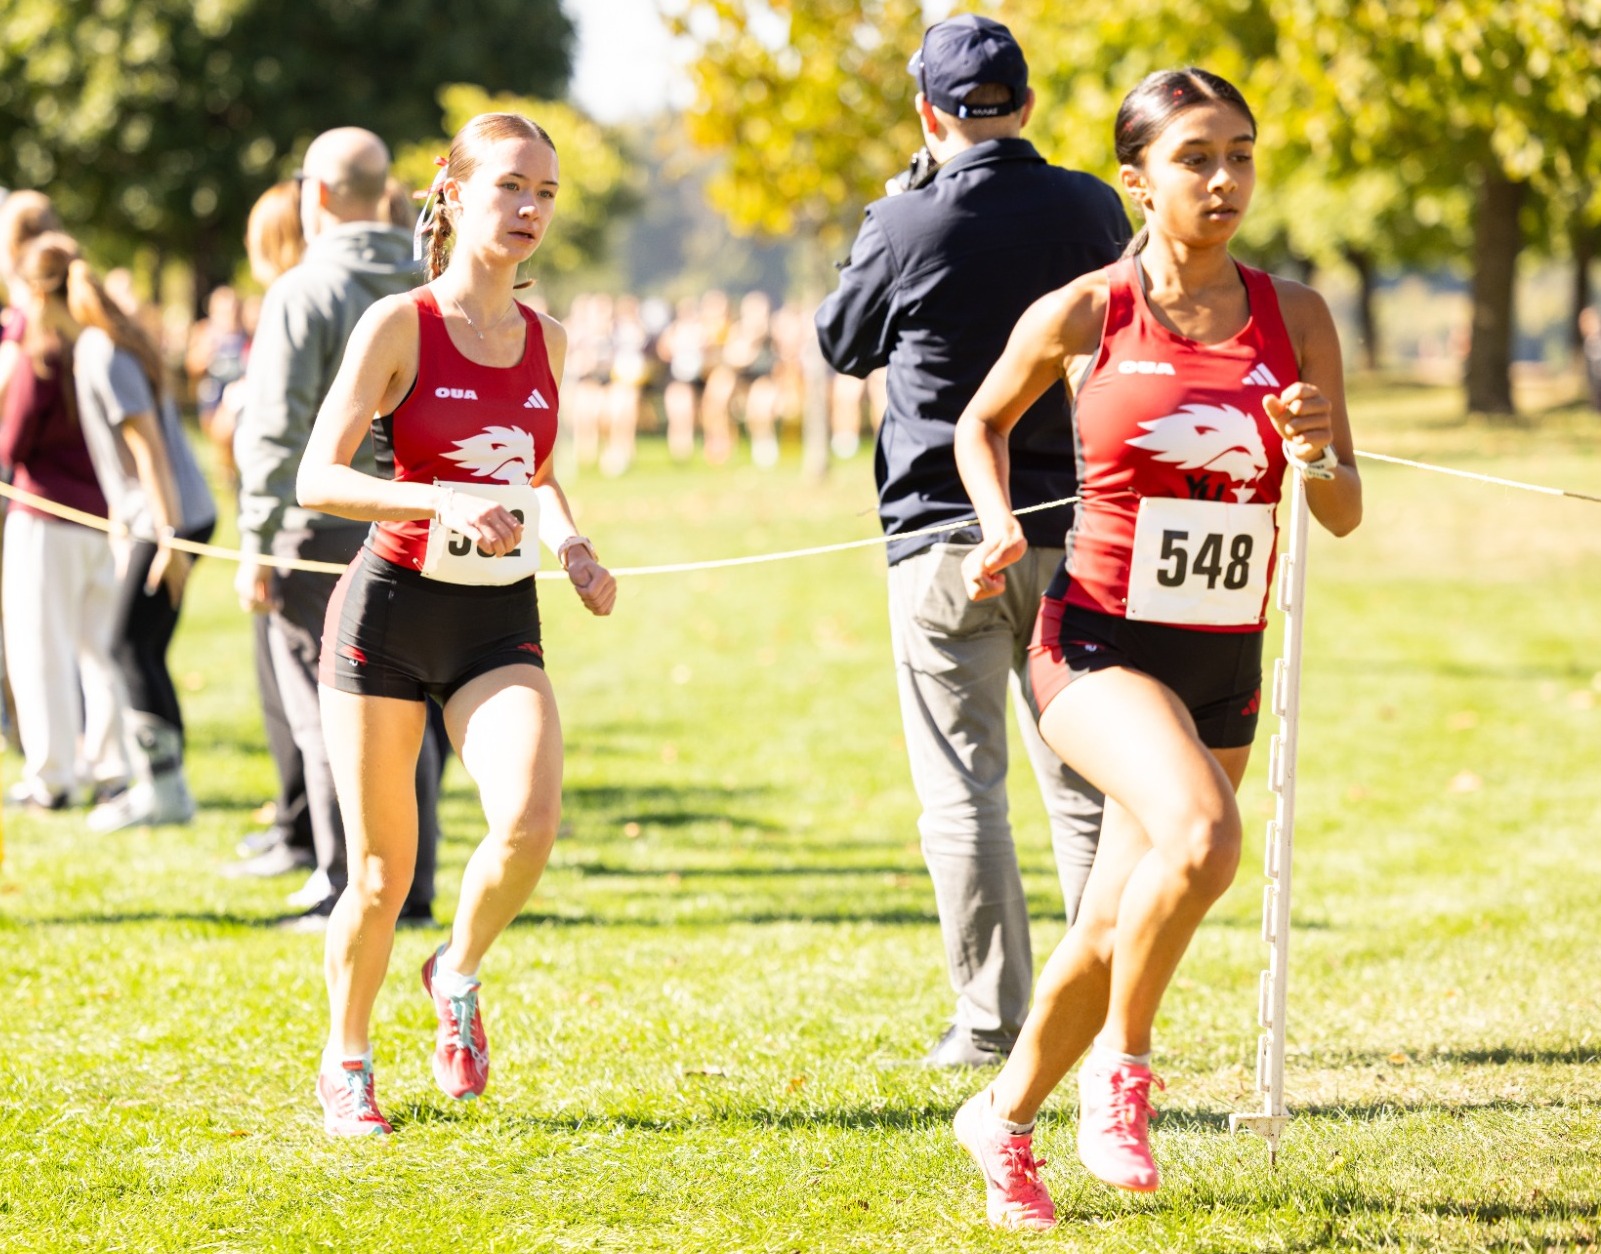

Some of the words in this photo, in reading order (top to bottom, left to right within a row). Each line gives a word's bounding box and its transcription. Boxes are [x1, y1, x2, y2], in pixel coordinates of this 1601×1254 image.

[1117, 360, 1176, 376] OUA
[435, 387, 478, 400] OUA
[1156, 529, 1254, 590] 548
